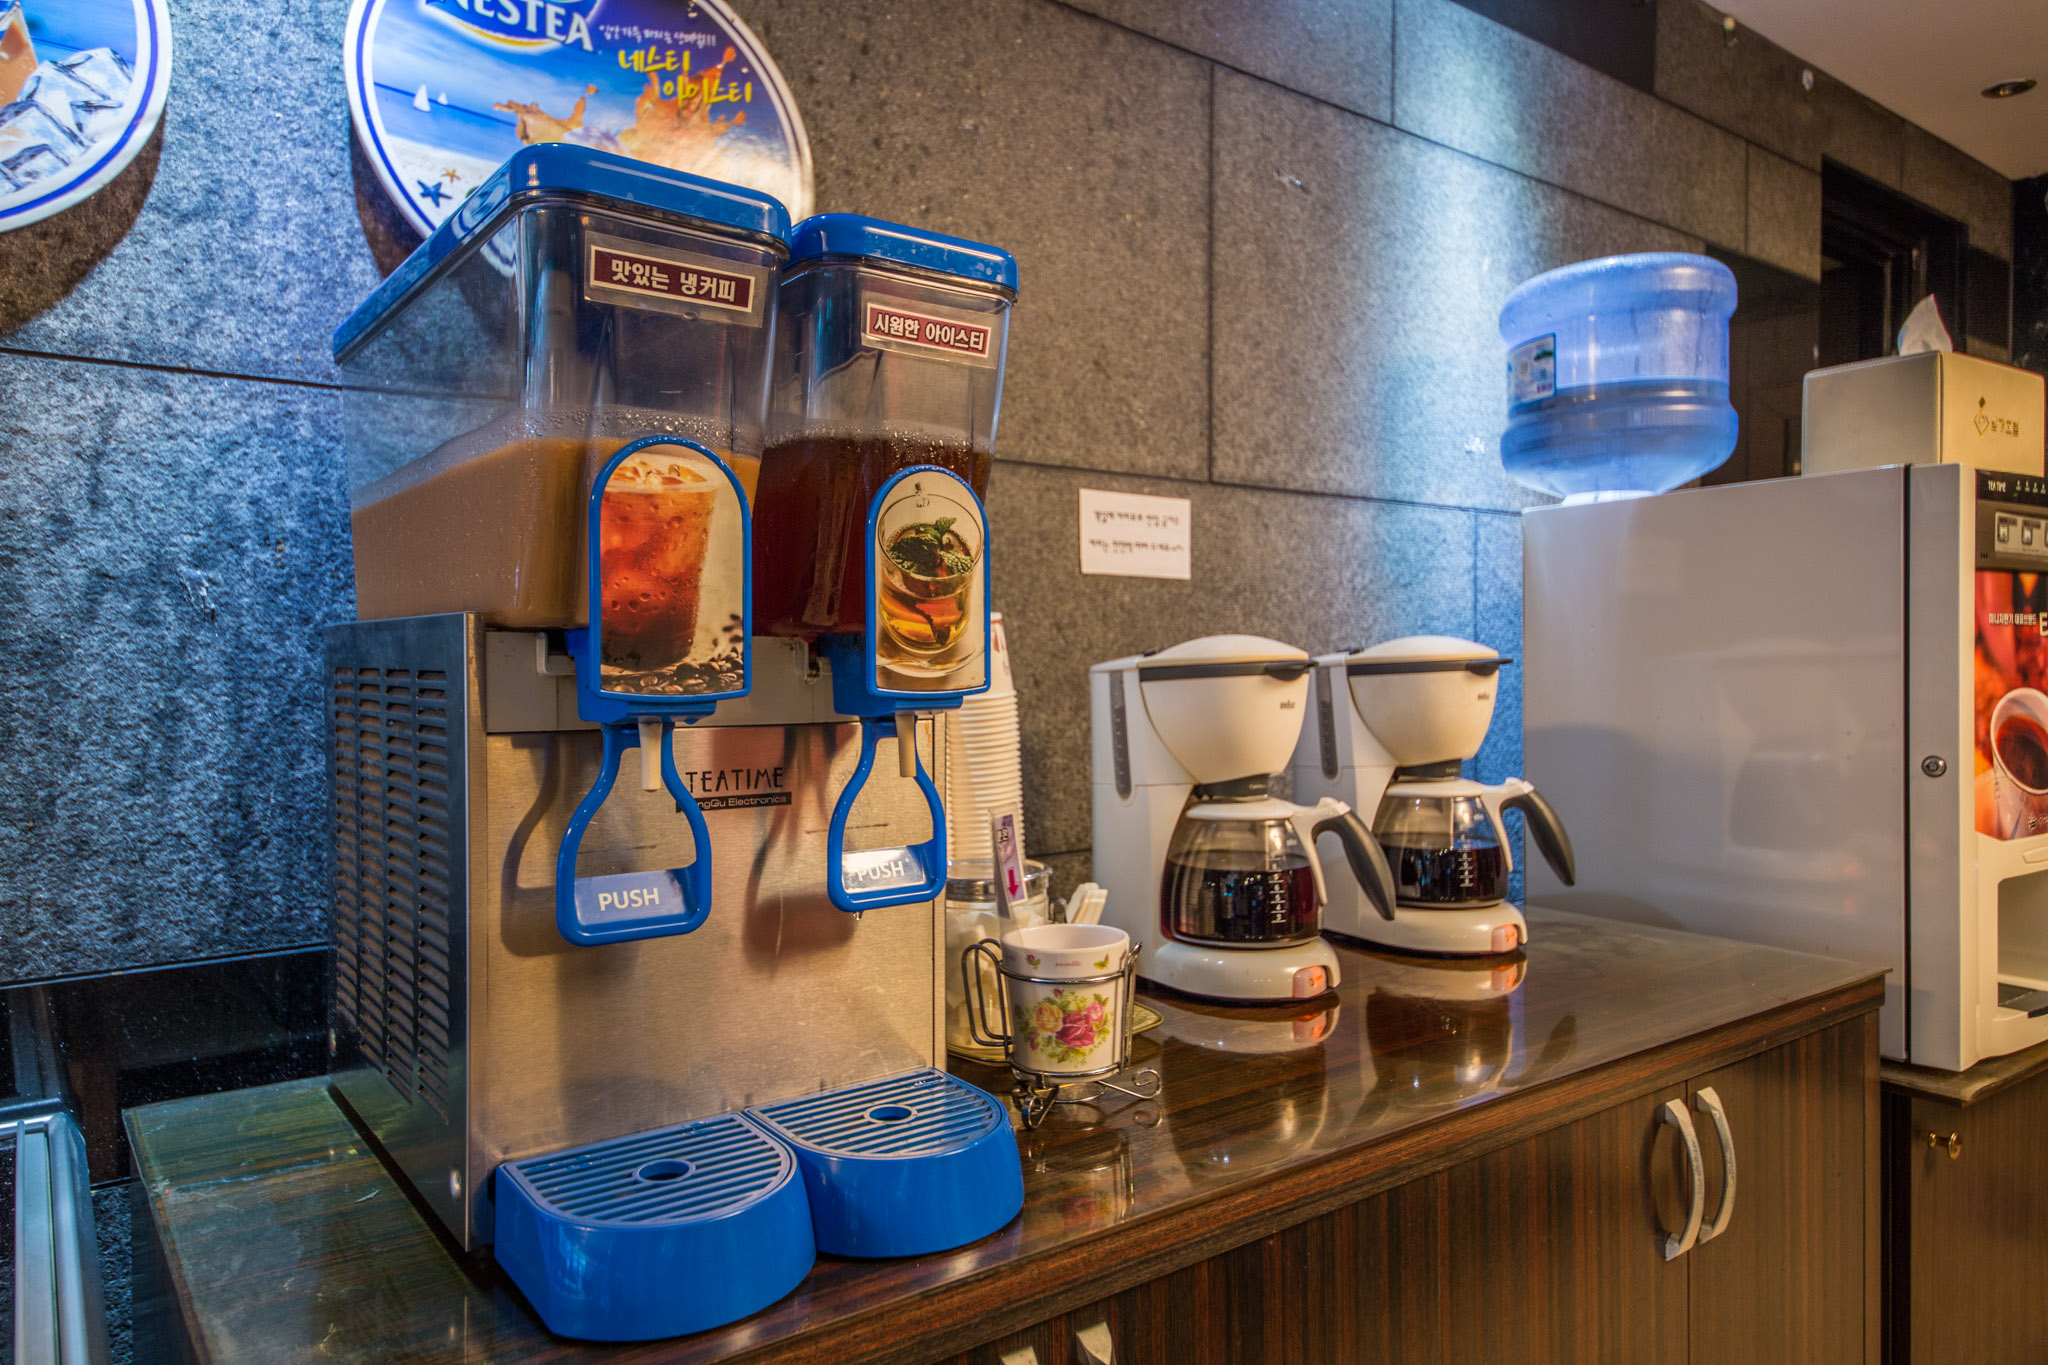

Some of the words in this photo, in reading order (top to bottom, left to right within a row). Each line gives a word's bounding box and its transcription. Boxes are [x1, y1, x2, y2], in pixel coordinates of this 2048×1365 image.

[618, 45, 691, 73] 네스티
[663, 74, 752, 109] 아이스티
[611, 258, 670, 291] 맛있는
[680, 271, 736, 303] 냉커피
[873, 313, 920, 340] 시원한
[925, 322, 985, 351] 아이스티
[685, 767, 784, 793] TEATIME
[728, 796, 787, 807] Electronics
[858, 860, 905, 882] PUSH
[598, 887, 660, 911] PUSH
